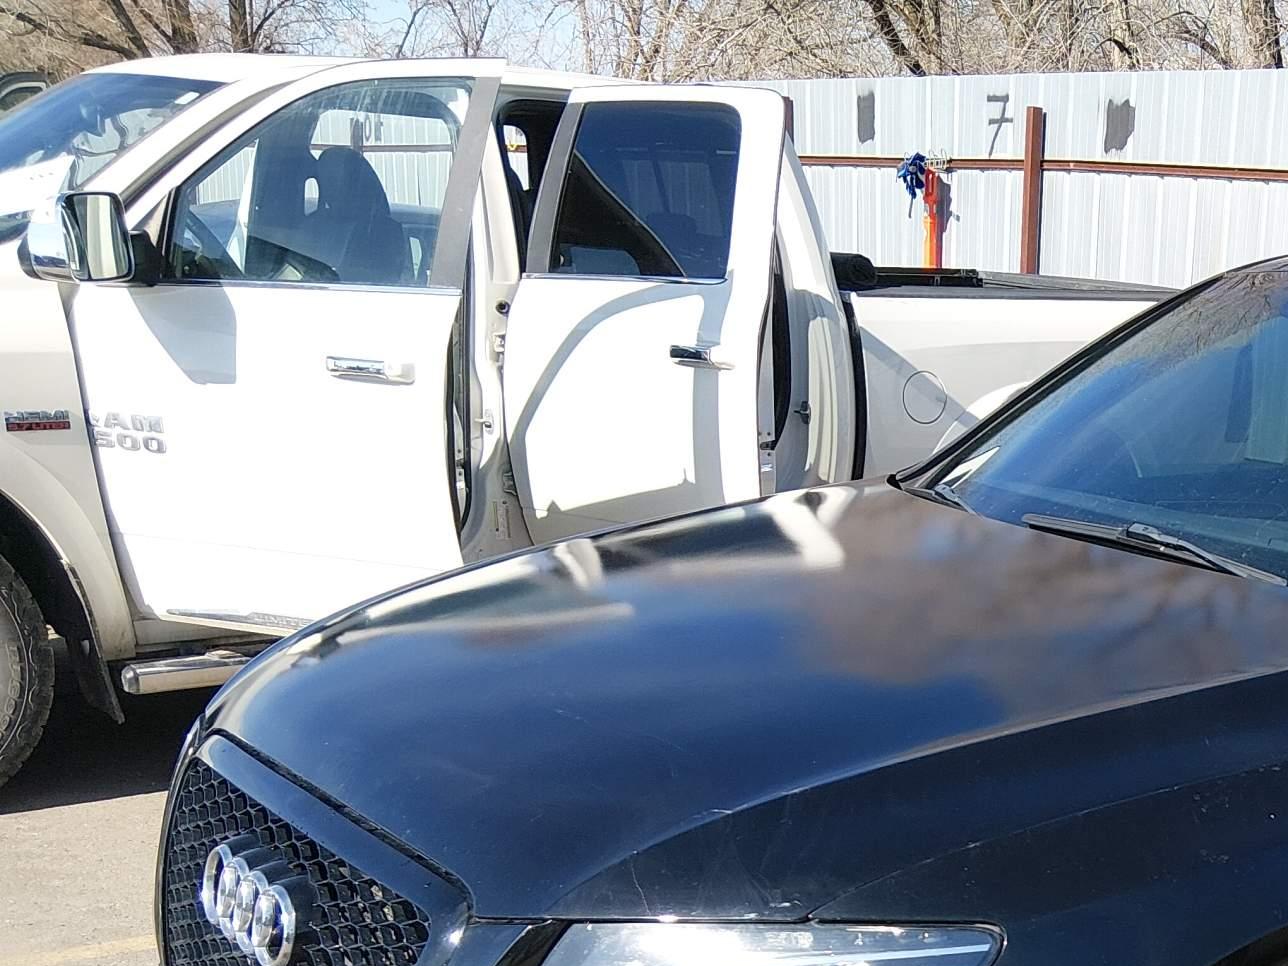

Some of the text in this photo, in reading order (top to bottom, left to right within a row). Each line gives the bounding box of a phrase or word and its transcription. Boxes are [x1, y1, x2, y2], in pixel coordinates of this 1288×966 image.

[986, 93, 1013, 158] 7
[4, 410, 70, 422] HEMI
[95, 430, 167, 454] 500
